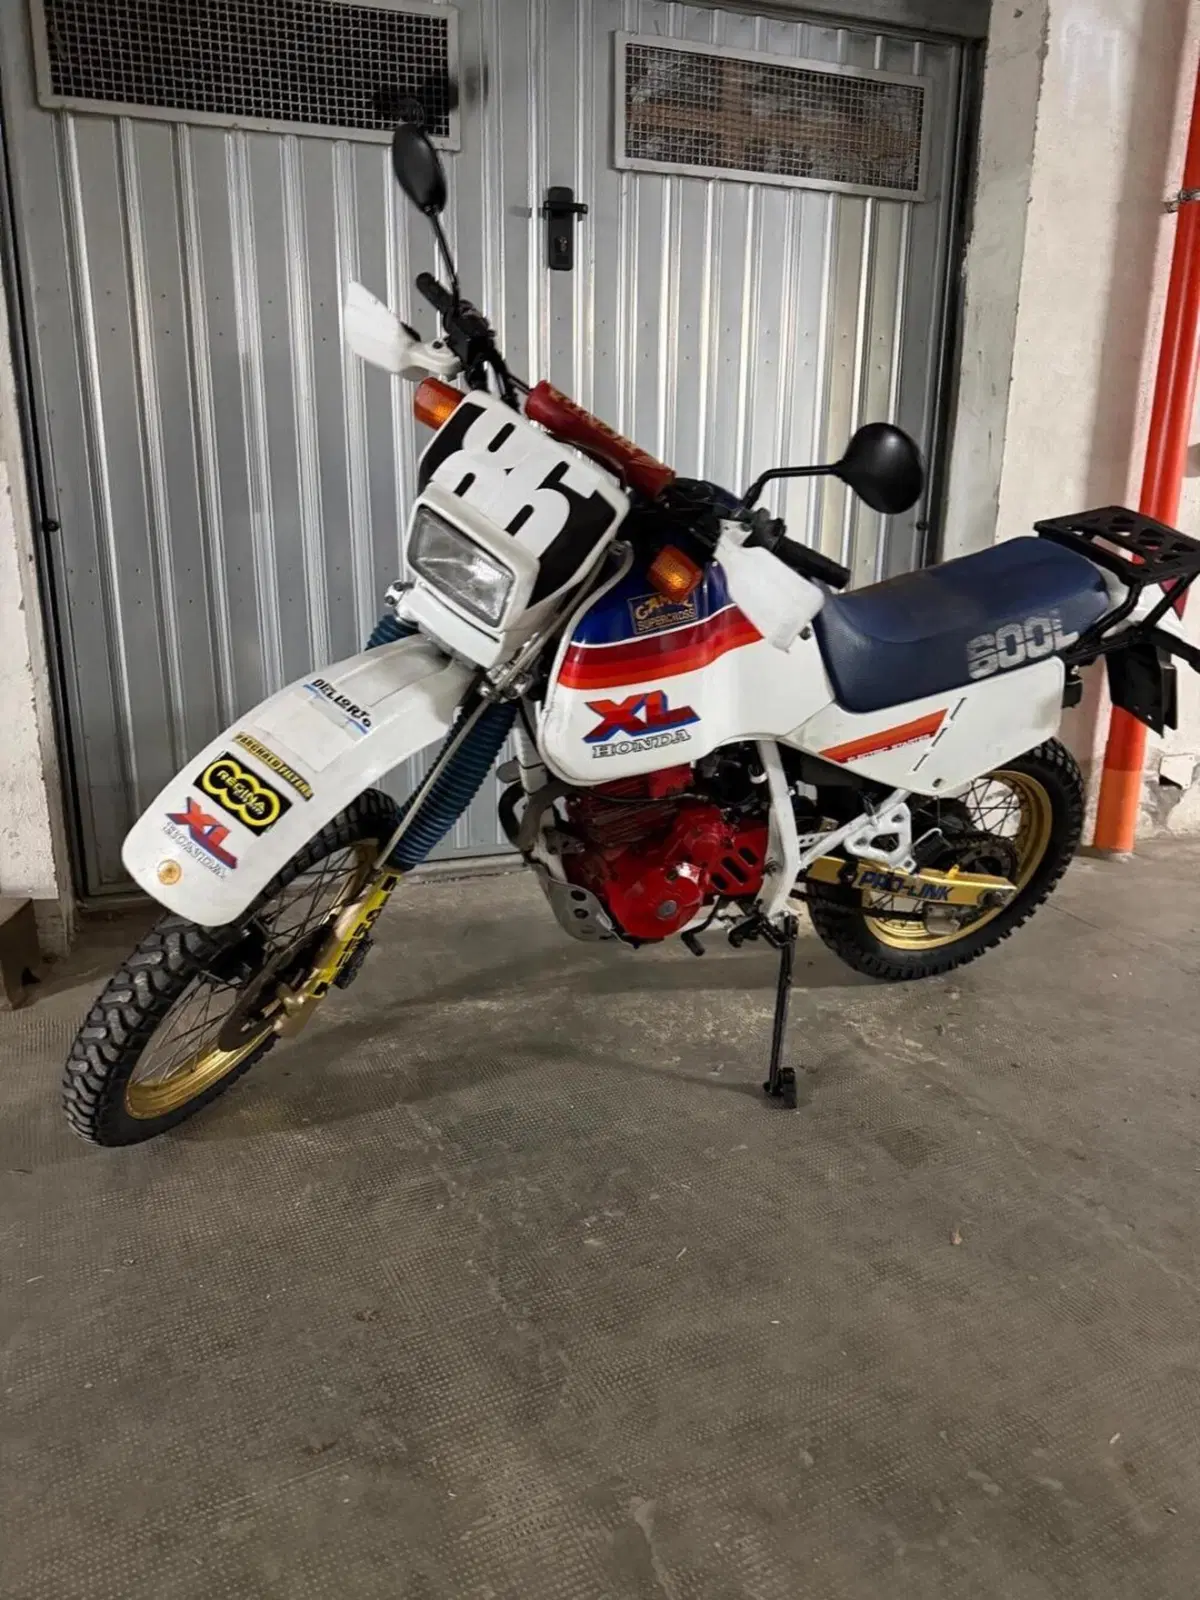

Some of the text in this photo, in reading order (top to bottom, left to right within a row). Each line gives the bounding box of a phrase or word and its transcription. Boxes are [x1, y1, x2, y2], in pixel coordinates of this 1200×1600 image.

[966, 608, 1080, 680] 600L
[582, 689, 701, 744] XL
[592, 729, 692, 759] HONDA
[216, 770, 266, 813] REGINA
[162, 820, 228, 880] HONDA
[164, 796, 238, 869] XL
